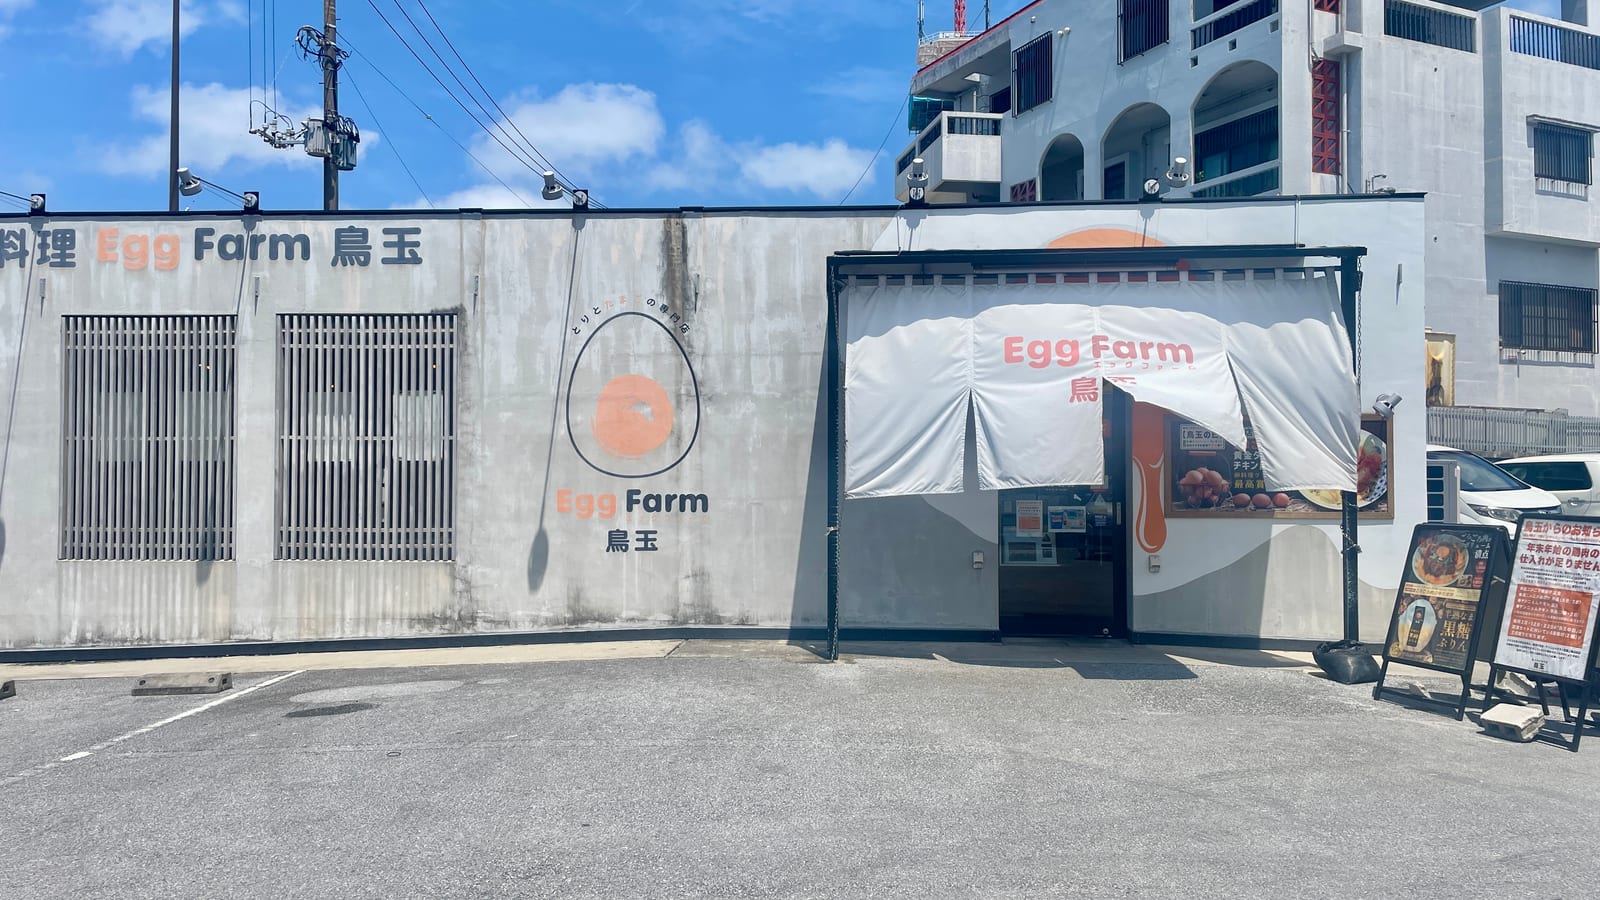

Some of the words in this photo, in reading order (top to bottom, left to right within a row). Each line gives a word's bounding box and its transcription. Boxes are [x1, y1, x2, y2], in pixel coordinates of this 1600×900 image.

[97, 227, 181, 270] Egg
[194, 228, 311, 261] Farm
[331, 225, 423, 267] 鳥玉
[1004, 336, 1080, 369] Egg
[1091, 335, 1194, 364] Farm
[556, 489, 617, 519] Egg
[626, 489, 709, 513] Farm
[606, 529, 658, 552] 鳥玉
